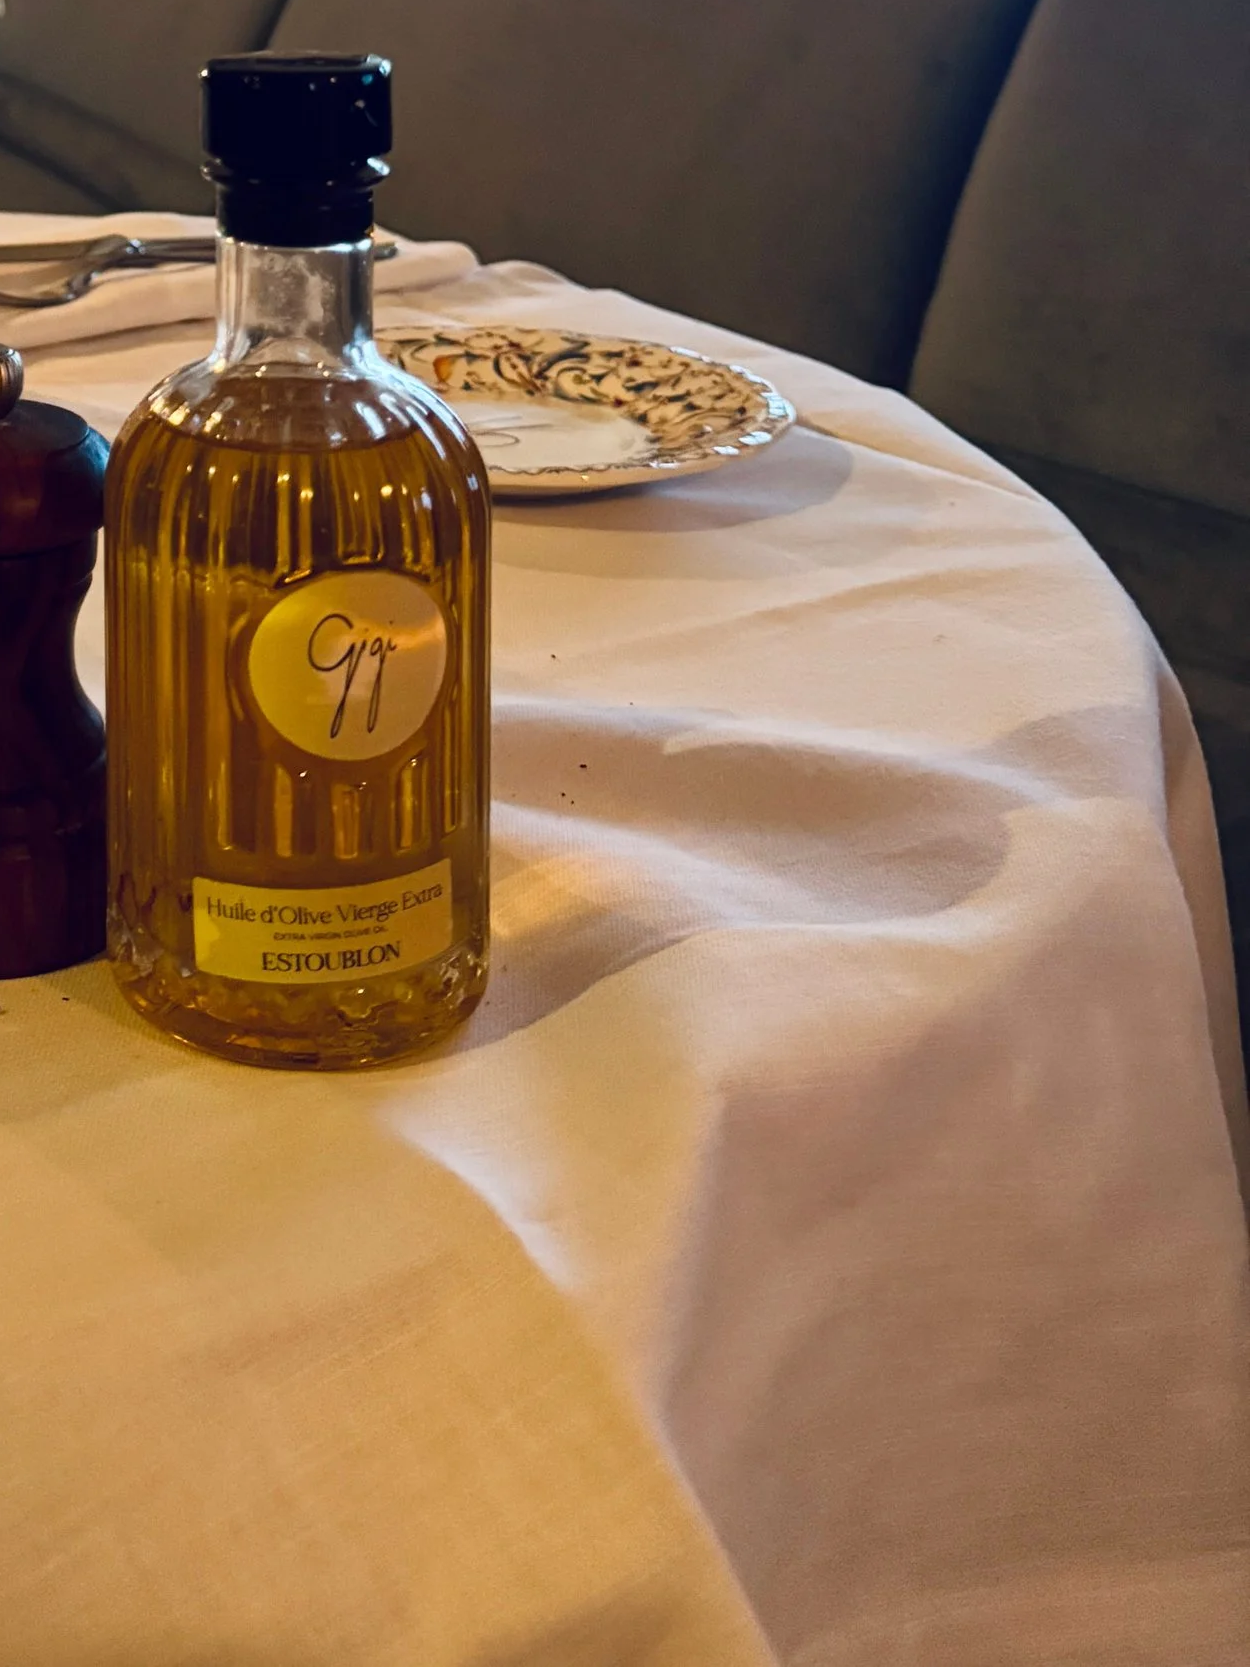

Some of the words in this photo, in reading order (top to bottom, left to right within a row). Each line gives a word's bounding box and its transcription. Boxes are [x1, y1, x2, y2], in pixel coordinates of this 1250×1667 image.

[307, 613, 398, 740] Gigi
[207, 896, 257, 923] Huile
[259, 905, 333, 925] d'Olive
[335, 899, 399, 923] Vierge
[401, 883, 443, 911] Extra
[261, 940, 402, 972] ESTOUBLON
